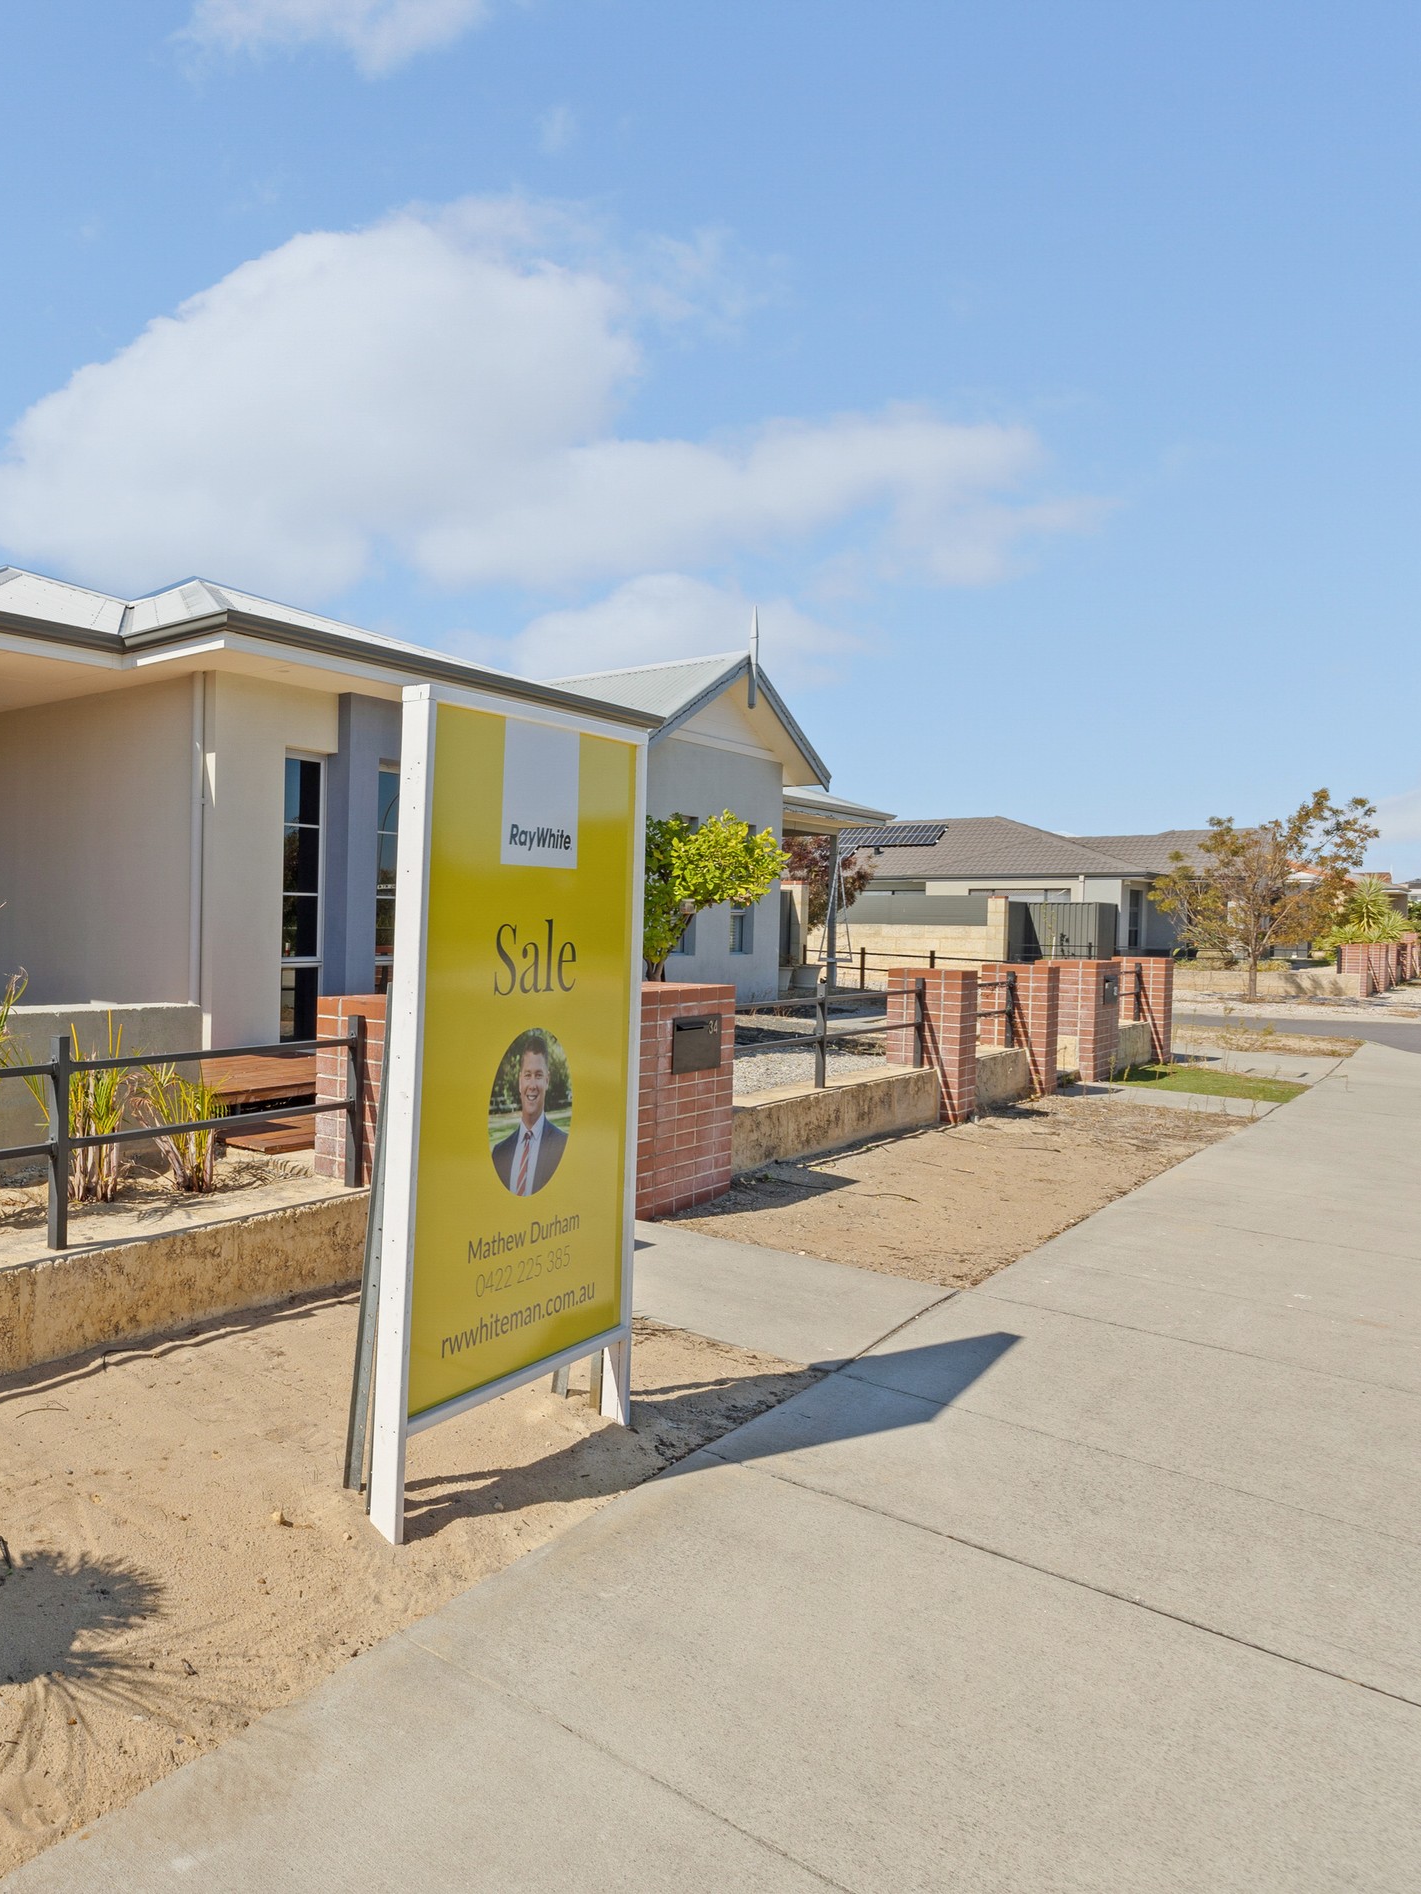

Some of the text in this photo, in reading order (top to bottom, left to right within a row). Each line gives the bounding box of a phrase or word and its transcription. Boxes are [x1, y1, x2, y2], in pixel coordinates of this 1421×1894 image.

[493, 918, 577, 996] Sale
[708, 1020, 718, 1035] 34
[467, 1214, 580, 1264] Mathew Durham
[476, 1245, 571, 1298] 0422 225 385
[441, 1282, 595, 1359] rwwhiteman.com.au
